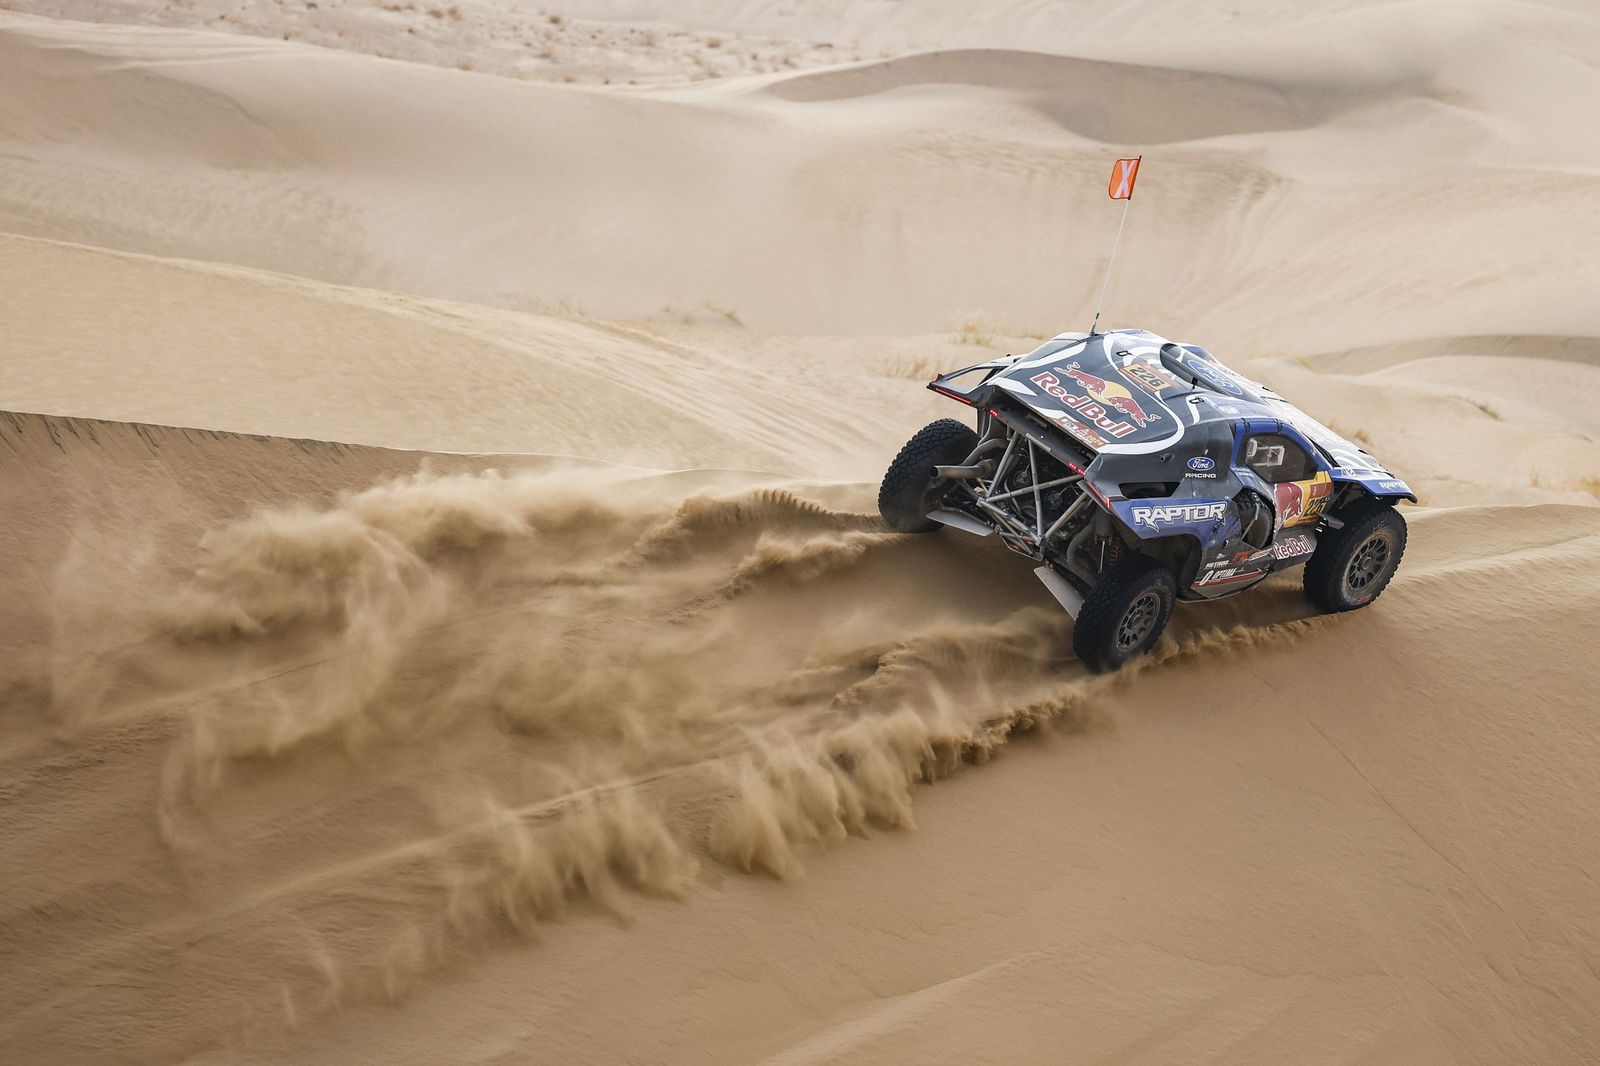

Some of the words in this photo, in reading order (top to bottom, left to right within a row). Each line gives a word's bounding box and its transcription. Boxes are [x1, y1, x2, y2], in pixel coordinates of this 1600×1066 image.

[1129, 367, 1165, 387] 226
[1030, 371, 1093, 409] Red
[1077, 402, 1137, 439] Bull
[1191, 458, 1210, 469] Ford
[1131, 501, 1228, 533] RAPTOR
